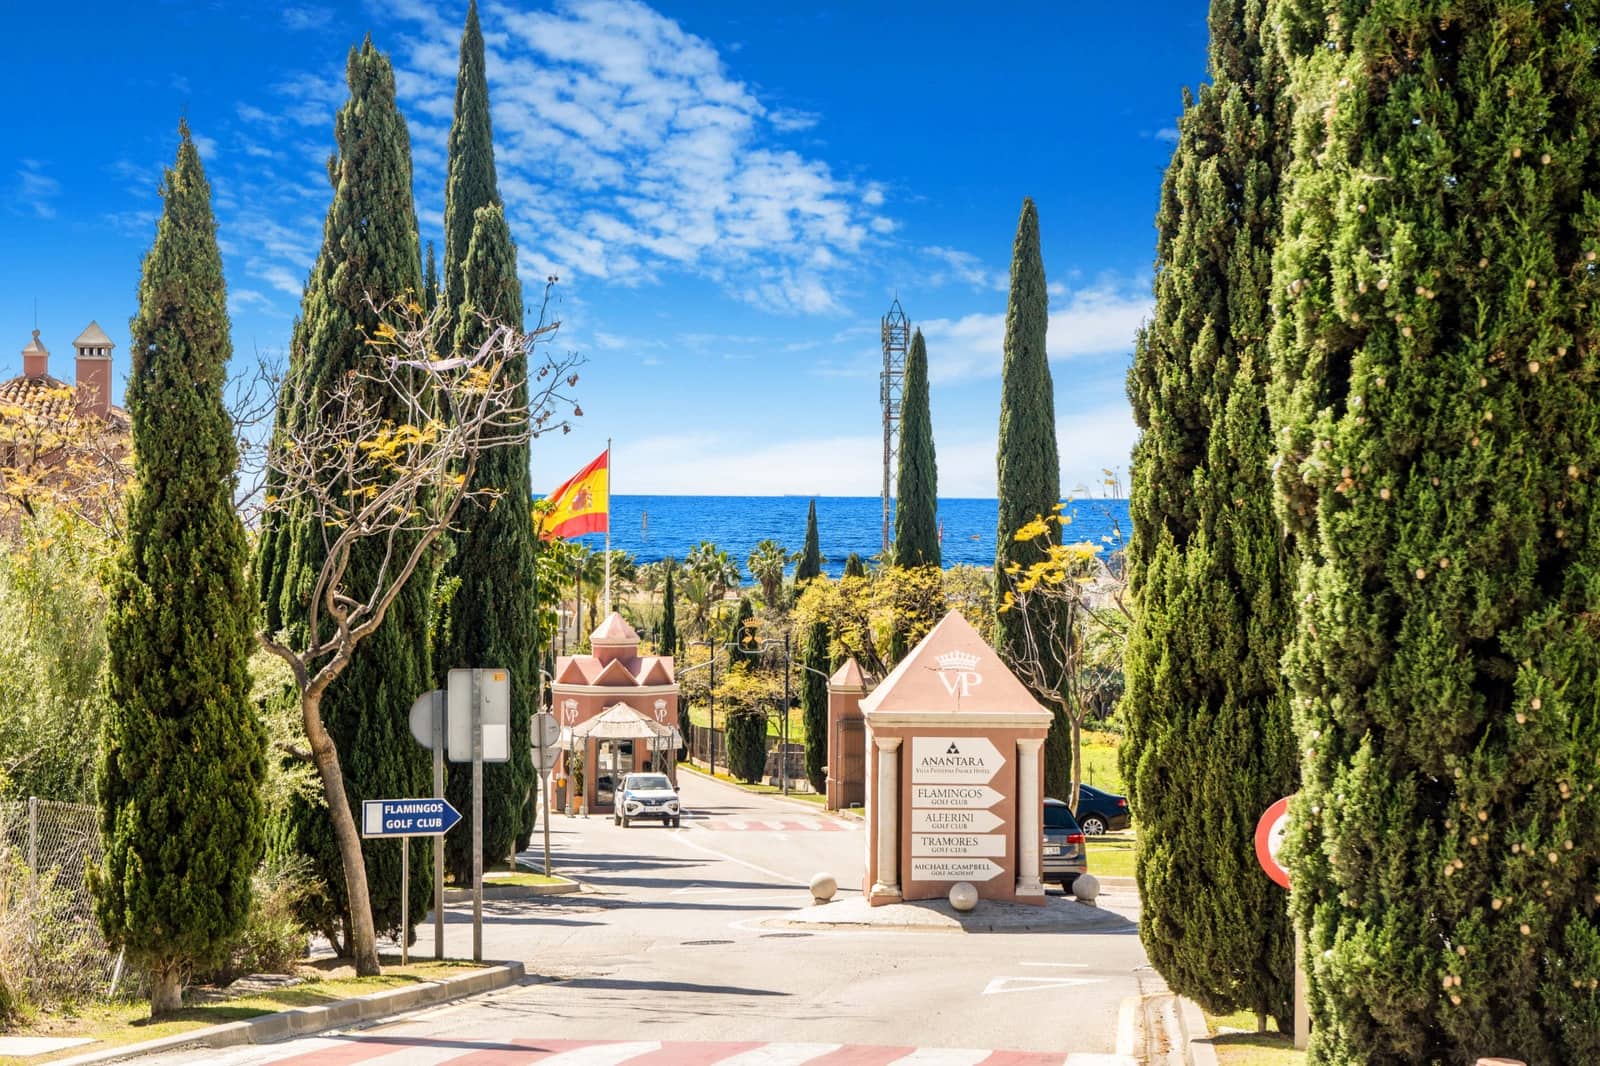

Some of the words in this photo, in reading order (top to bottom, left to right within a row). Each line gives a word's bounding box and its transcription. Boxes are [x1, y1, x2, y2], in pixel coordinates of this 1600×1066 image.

[937, 671, 983, 697] VP
[921, 757, 985, 767] ANANTARA
[918, 788, 983, 798] FLAMINGOS
[384, 803, 444, 814] FLAMINGOS
[925, 813, 974, 822] ALFERINI
[386, 819, 413, 829] GOLF
[416, 818, 442, 828] CLUB
[920, 837, 978, 847] TRAMORES
